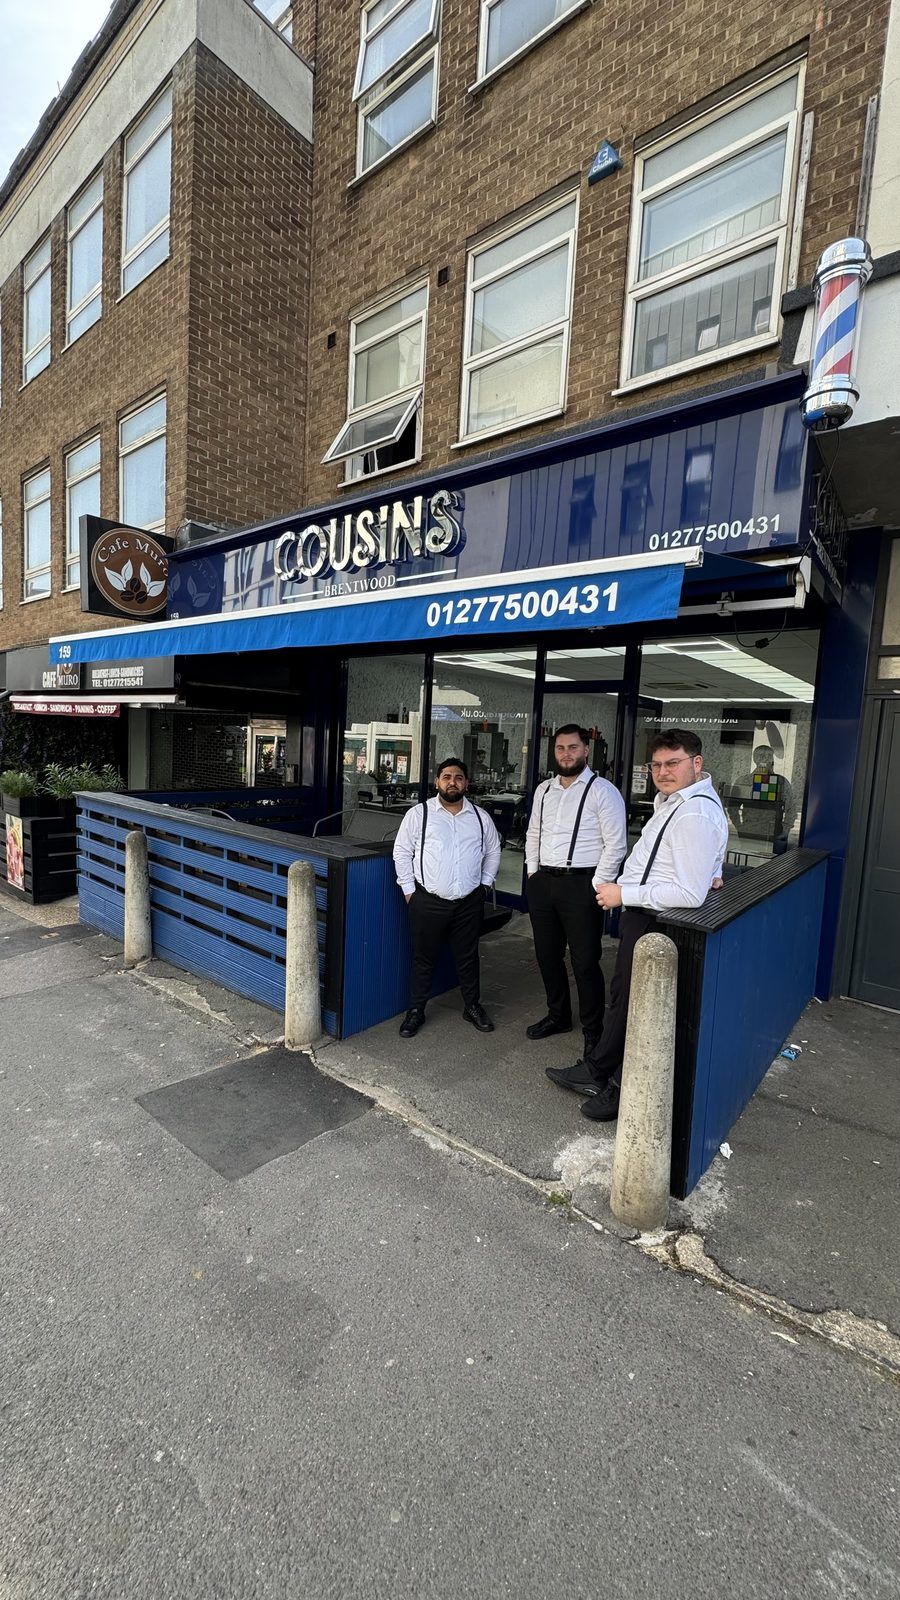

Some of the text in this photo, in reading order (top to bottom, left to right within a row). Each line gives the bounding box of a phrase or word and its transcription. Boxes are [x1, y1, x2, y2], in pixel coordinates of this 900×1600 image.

[274, 490, 466, 582] COUSINS
[649, 514, 780, 550] 01277500431
[97, 538, 130, 562] Cafe
[324, 574, 396, 597] BRENTWOOD
[426, 582, 619, 627] 01277500431
[59, 645, 71, 659] 159
[42, 671, 79, 688] CAFE MURO
[92, 679, 103, 688] TEL:
